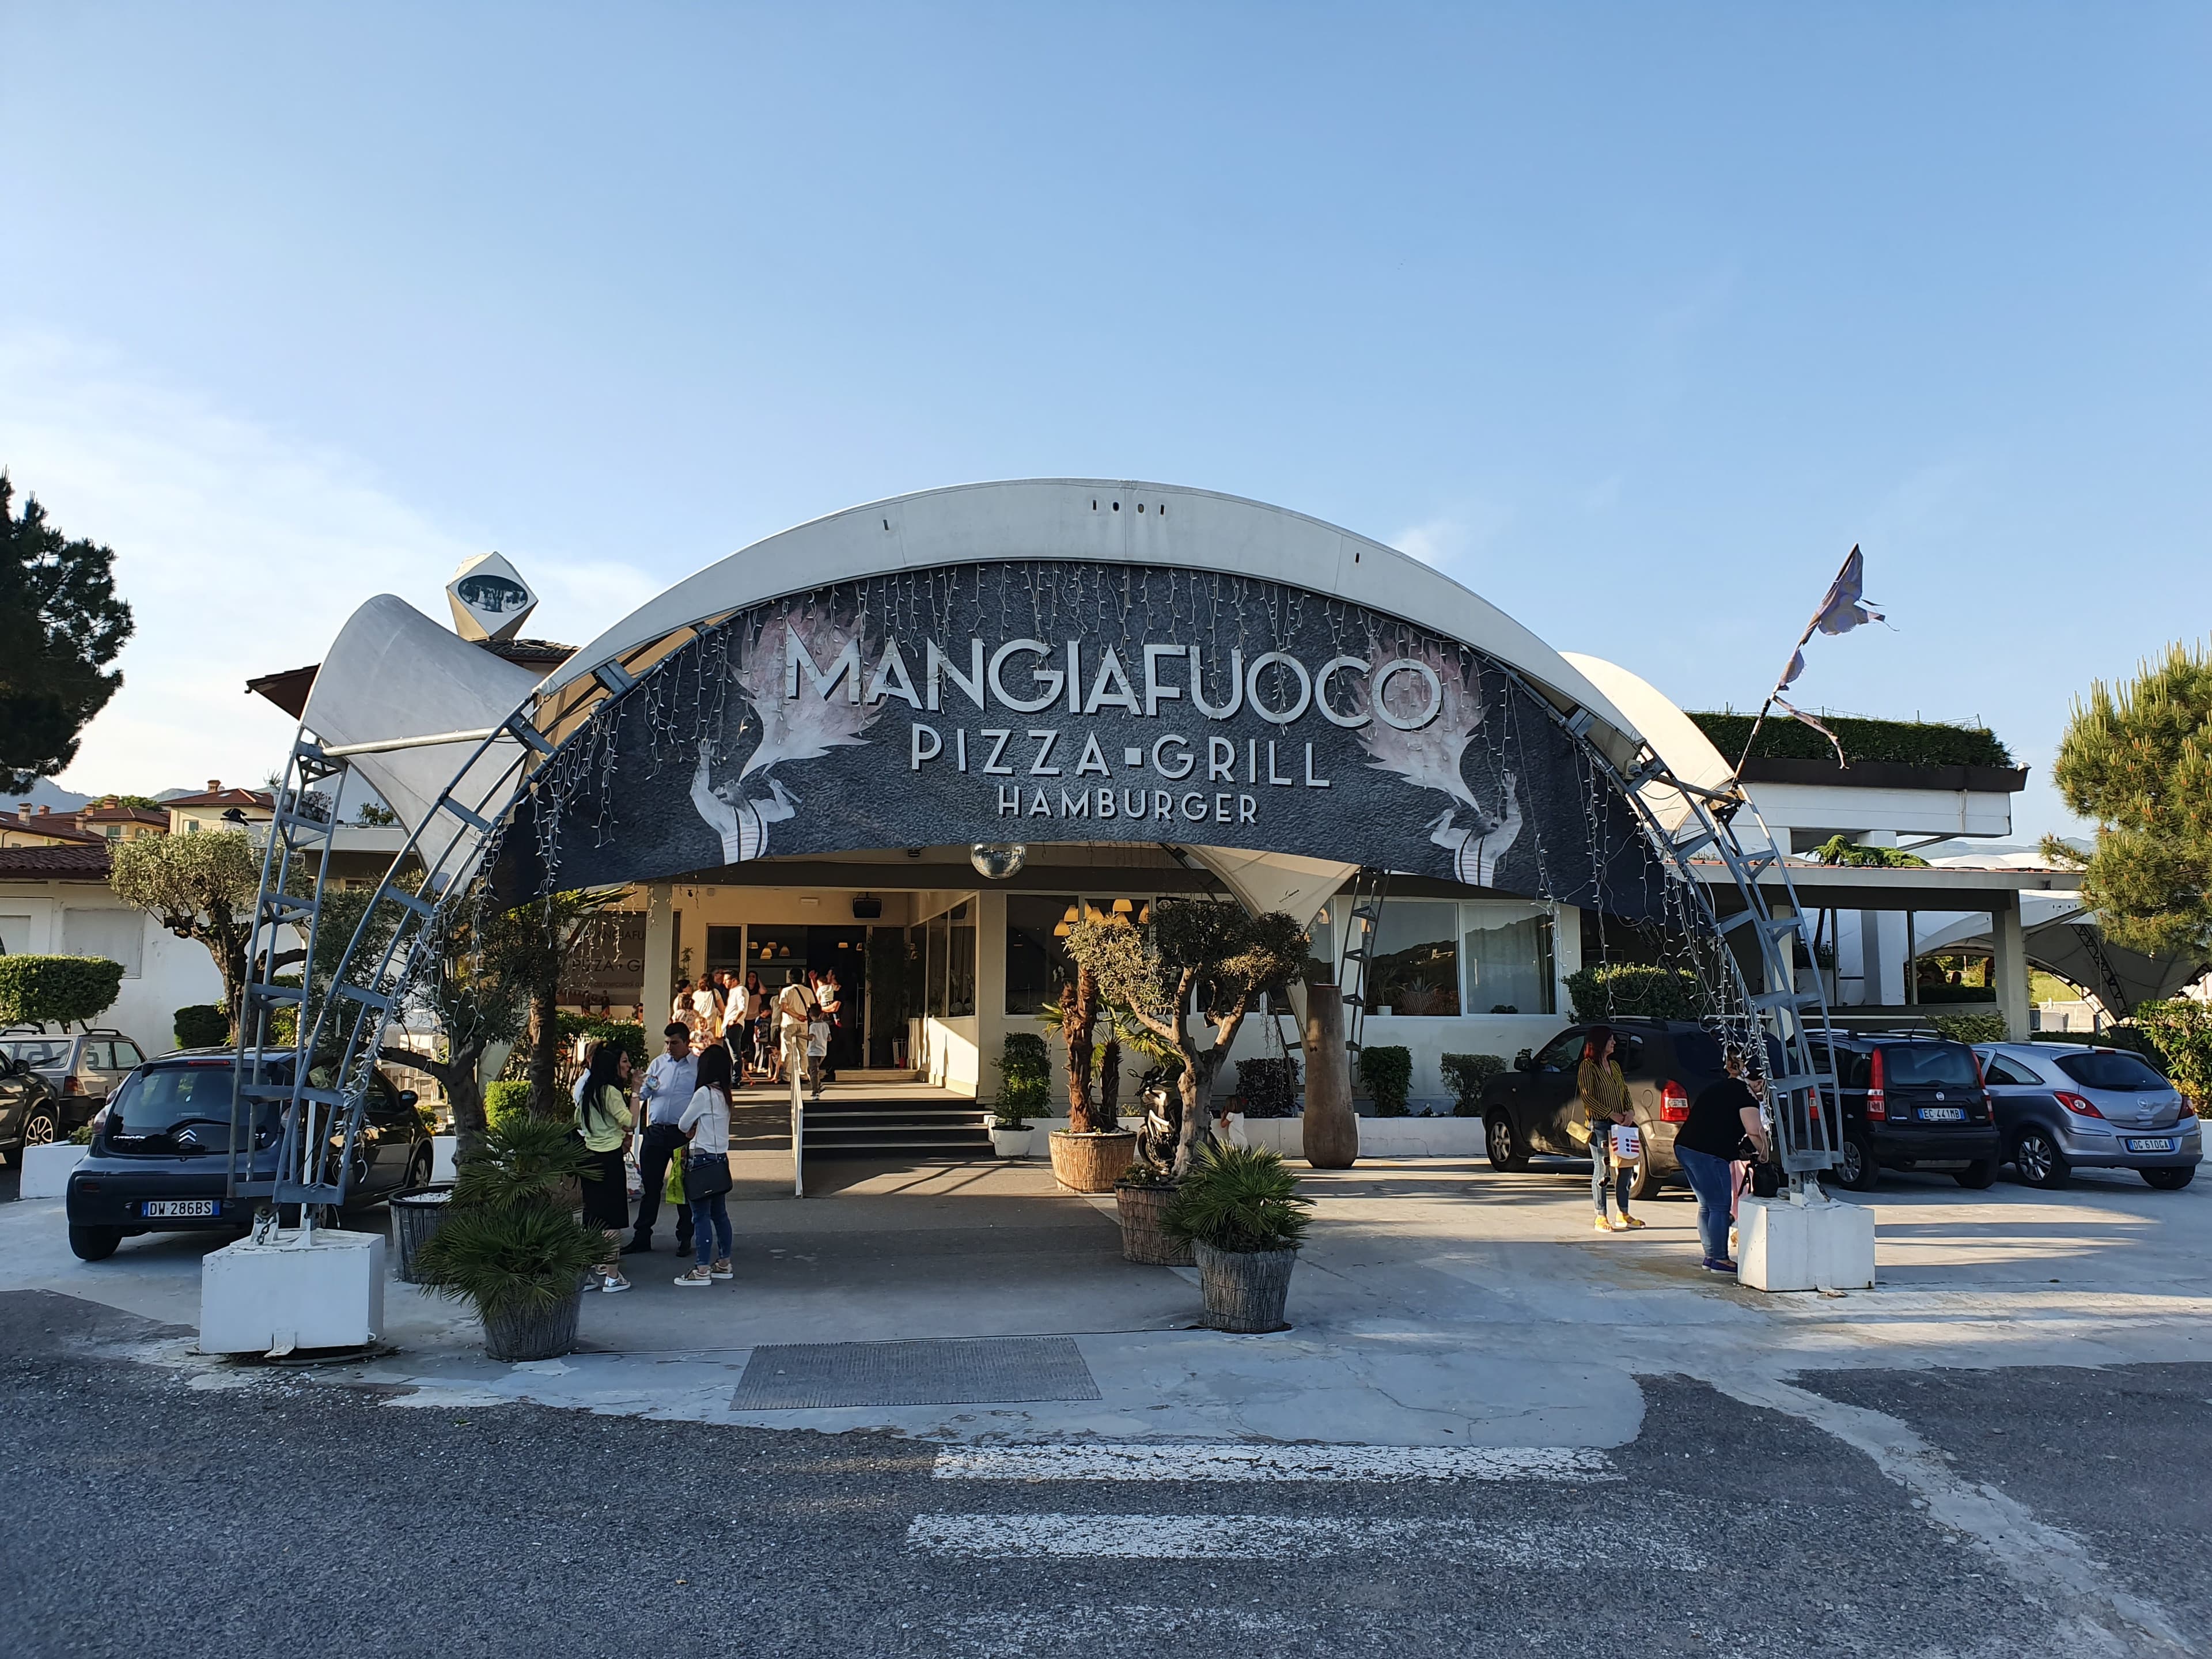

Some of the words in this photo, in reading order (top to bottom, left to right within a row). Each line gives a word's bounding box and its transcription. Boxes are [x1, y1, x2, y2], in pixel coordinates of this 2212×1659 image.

[785, 619, 1442, 729] MANGIAFUOCO
[911, 723, 1110, 776] PIZZA
[1152, 734, 1330, 786] GRILL
[998, 785, 1257, 824] HAMBURGER
[150, 1203, 165, 1215] DW
[171, 1202, 211, 1215] 286BS
